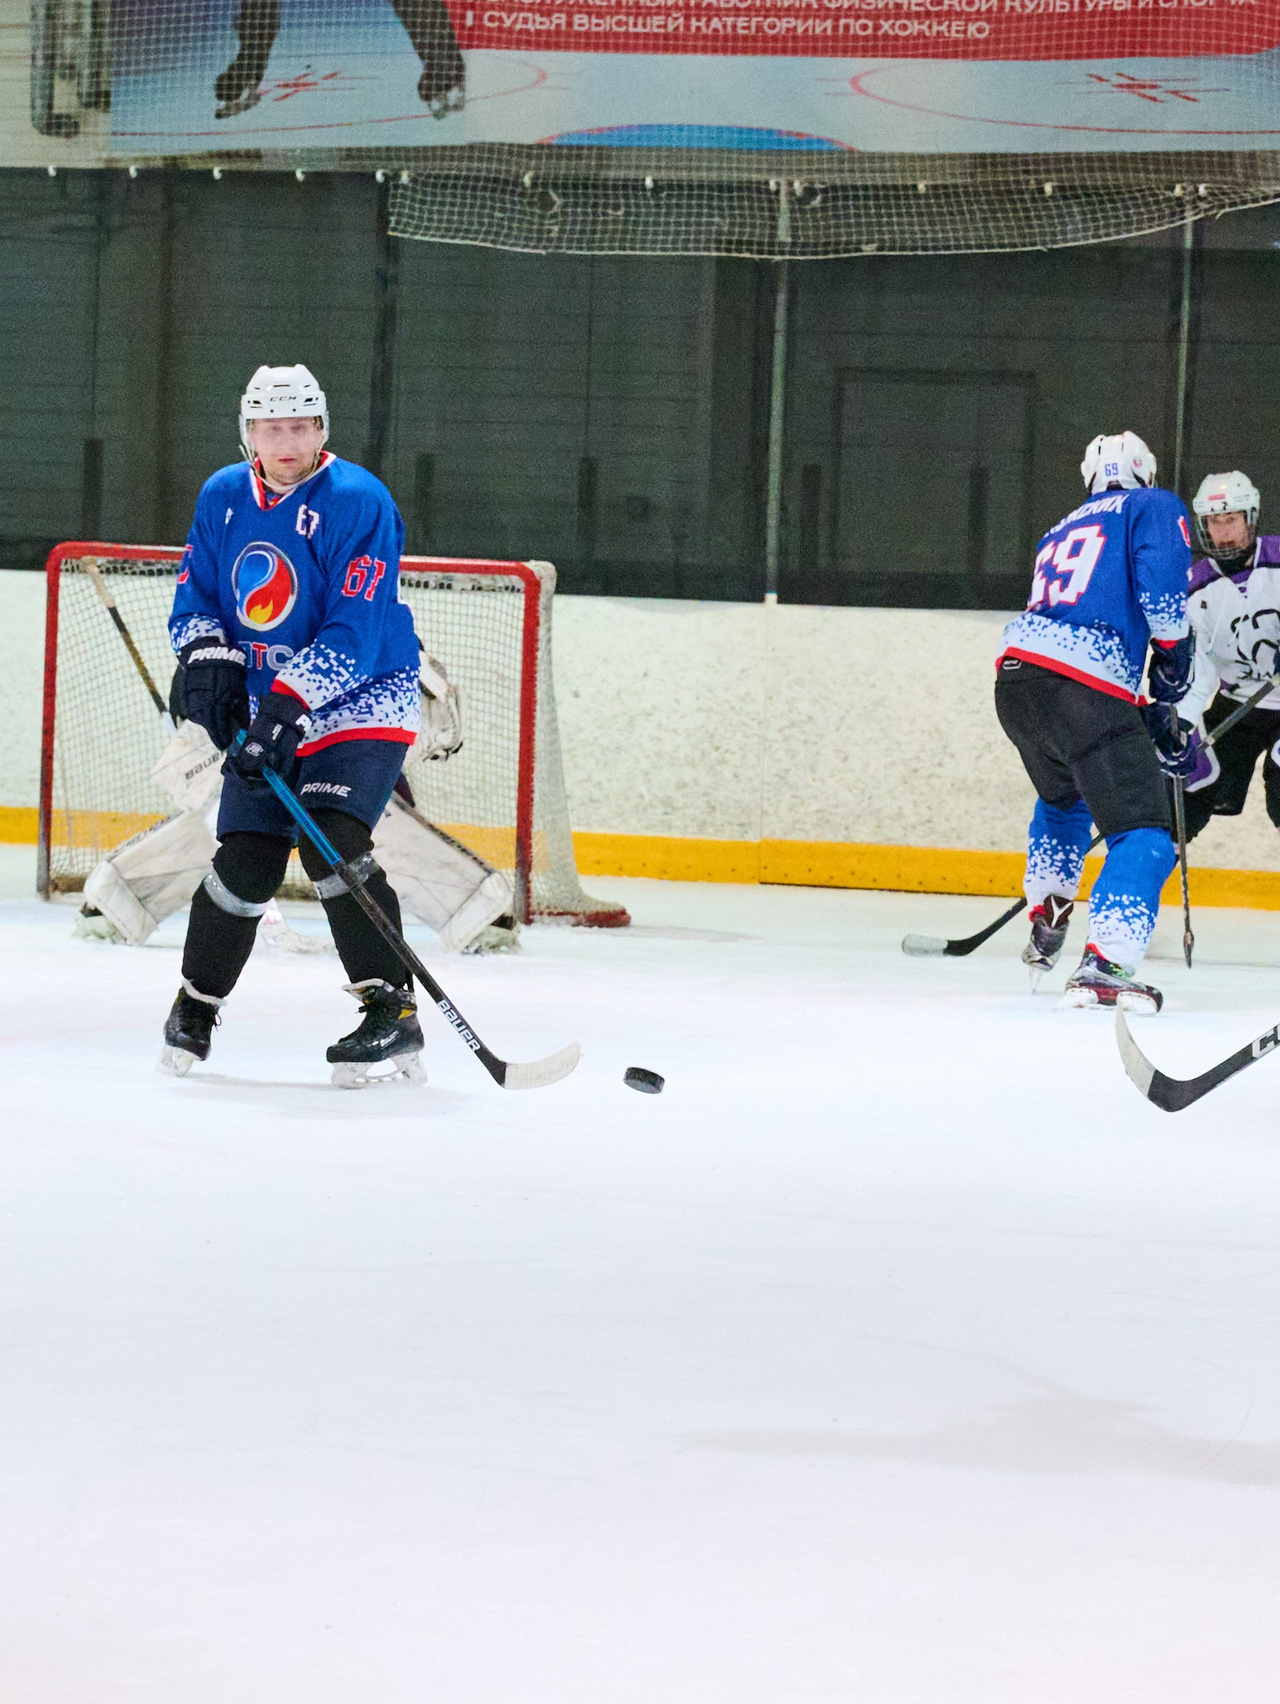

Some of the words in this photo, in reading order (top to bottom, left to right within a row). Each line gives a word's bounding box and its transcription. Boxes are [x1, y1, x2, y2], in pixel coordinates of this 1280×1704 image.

[483, 11, 566, 31] СУДЬЯ
[573, 12, 684, 33] ВЫСШЕЙ
[690, 16, 832, 35] КАТЕГОРИИ
[839, 19, 873, 36] ПО
[879, 19, 990, 38] ХОККЕЮ
[1104, 462, 1119, 477] 69
[187, 646, 247, 666] PRIME
[300, 782, 352, 799] PRIME
